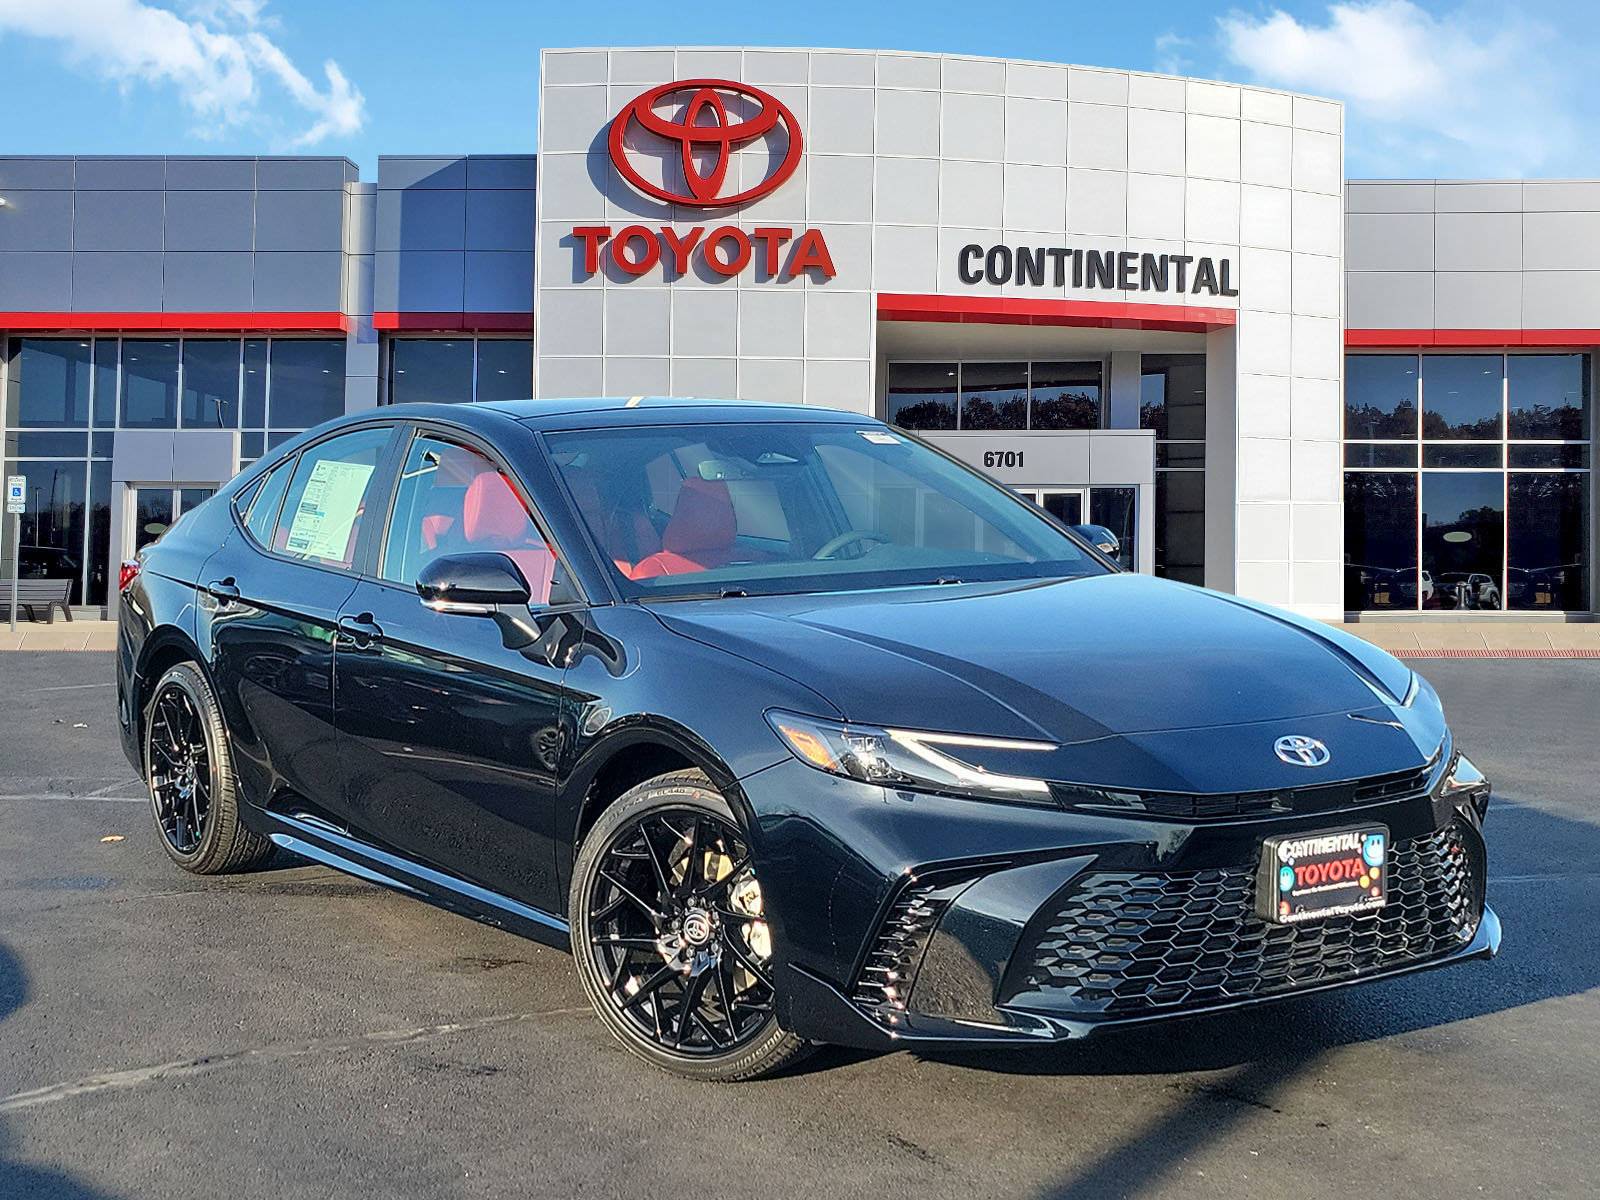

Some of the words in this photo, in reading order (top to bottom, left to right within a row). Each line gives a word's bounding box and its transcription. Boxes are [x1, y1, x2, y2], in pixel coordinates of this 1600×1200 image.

[573, 225, 836, 277] TOYOTA
[958, 243, 1239, 297] CONTINENTAL
[983, 451, 1024, 467] 6701
[1278, 832, 1361, 860] CONTINENTAL
[1294, 858, 1366, 886] TOYOTA
[1279, 900, 1386, 924] ContinentalToyota.com
